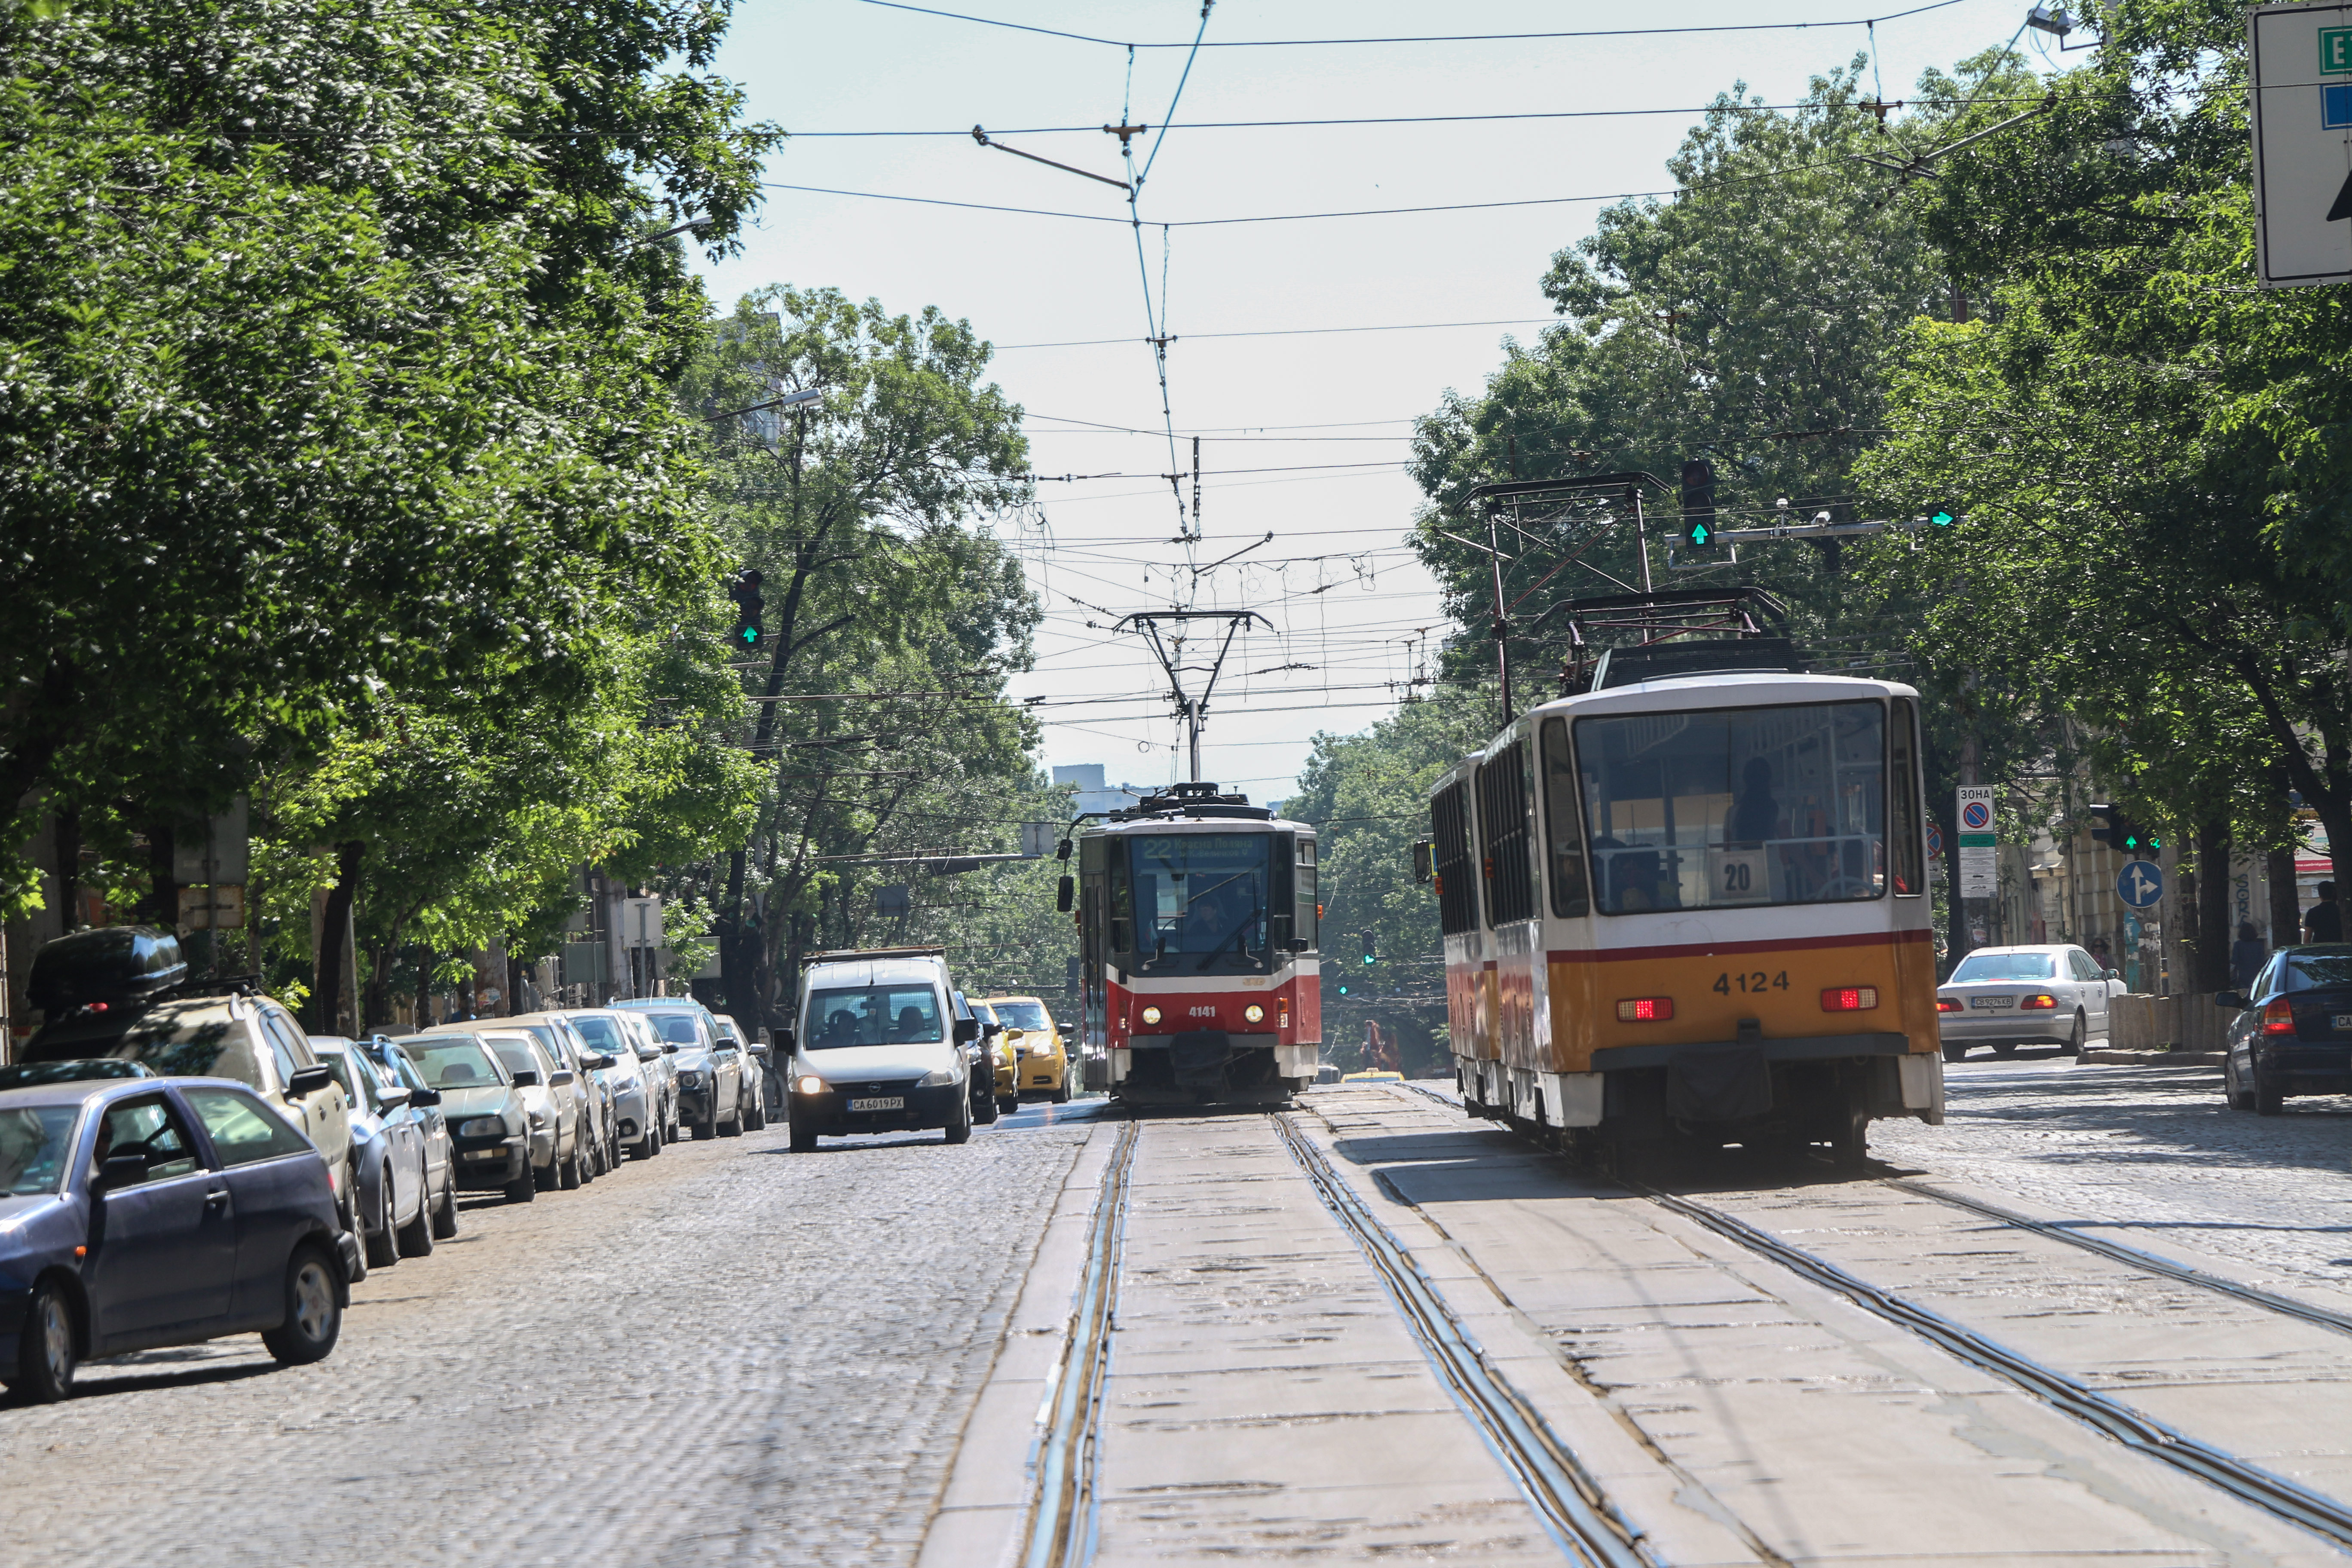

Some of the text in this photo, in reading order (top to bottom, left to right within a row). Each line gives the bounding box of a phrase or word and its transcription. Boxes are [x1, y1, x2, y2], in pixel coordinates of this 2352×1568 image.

[1961, 790, 1990, 799] ЗОНА
[1144, 839, 1172, 859] 22
[1724, 863, 1751, 891] 20
[1713, 970, 1790, 996] 4124
[1189, 1006, 1216, 1017] 4141
